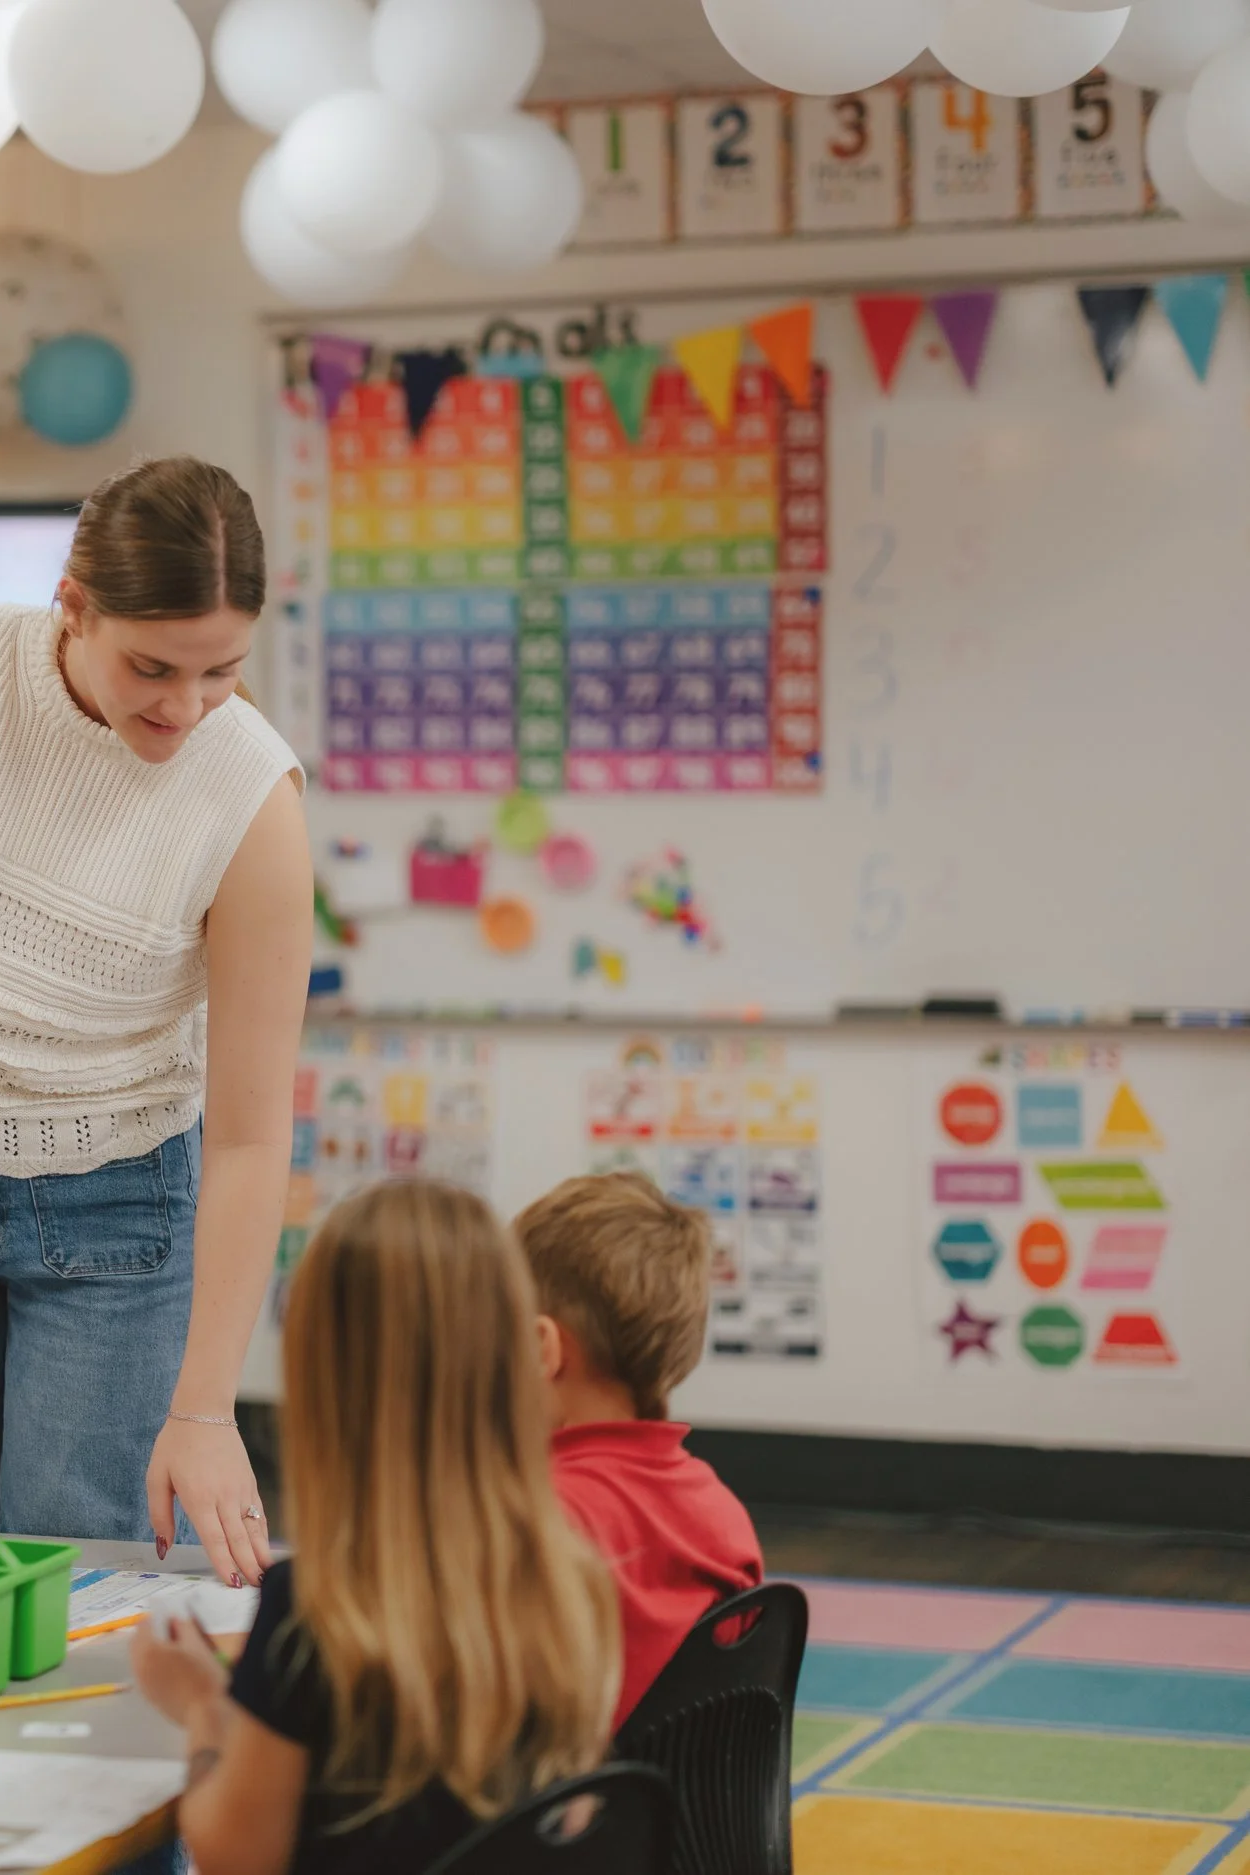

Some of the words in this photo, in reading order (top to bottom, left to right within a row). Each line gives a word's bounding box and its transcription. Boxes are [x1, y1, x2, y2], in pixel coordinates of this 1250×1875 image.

[711, 104, 750, 168] 2
[828, 92, 868, 160] 3
[941, 85, 990, 155] 4
[1072, 72, 1113, 143] 5
